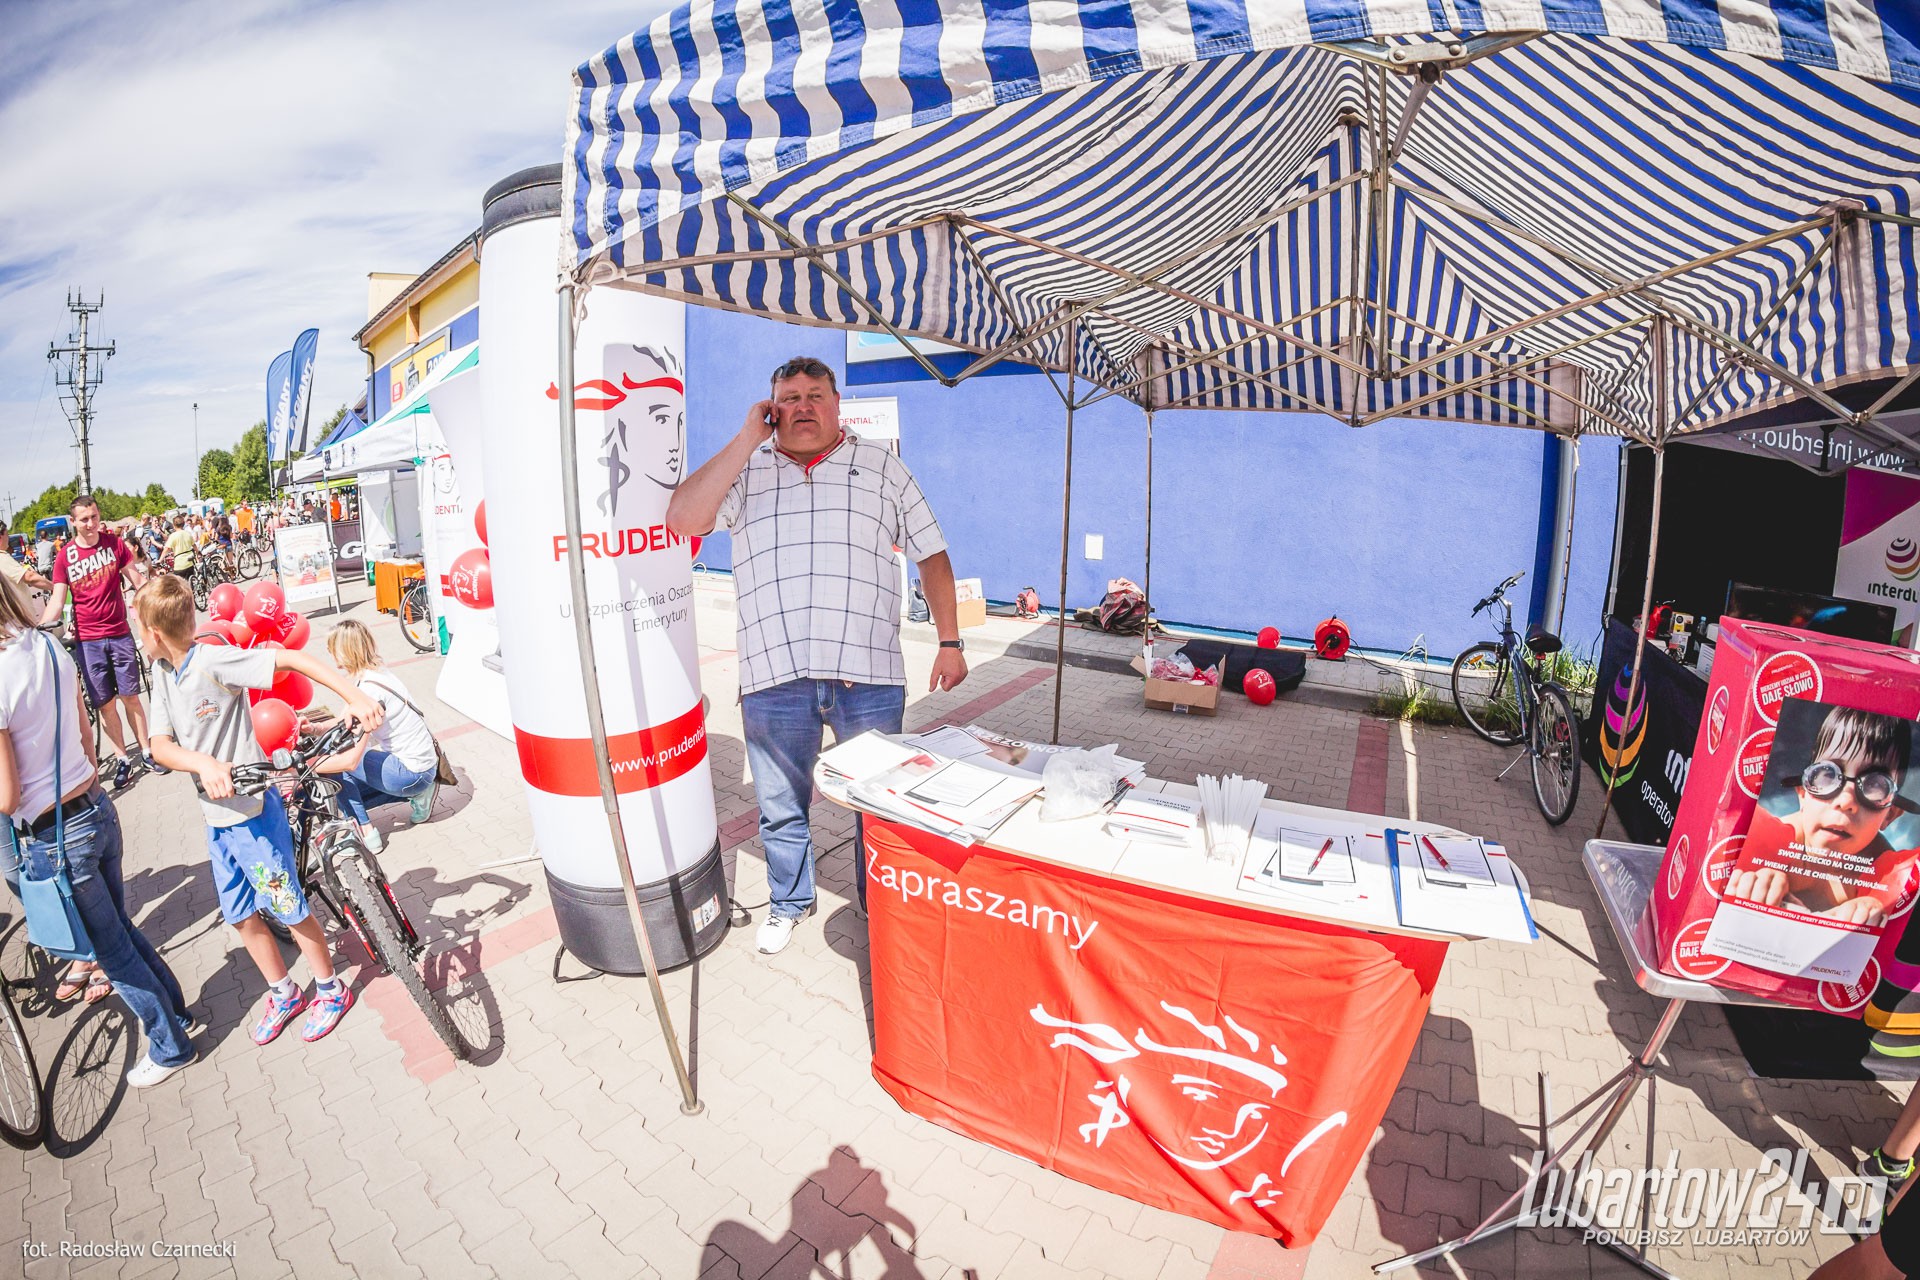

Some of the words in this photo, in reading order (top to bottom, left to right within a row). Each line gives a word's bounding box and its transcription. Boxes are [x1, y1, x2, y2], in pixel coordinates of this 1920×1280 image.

[294, 356, 315, 417] GIANT
[840, 417, 873, 425] DENTIAL
[435, 504, 463, 515] DENTI
[66, 544, 79, 564] 6
[553, 524, 690, 562] PRUDEN
[67, 546, 117, 583] ESPAÑA
[560, 591, 666, 620] Uezpieczenia
[633, 607, 688, 633] Emerytury
[1783, 676, 1814, 698] SŁOWO
[1640, 780, 1675, 829] operator
[1778, 849, 1802, 860] SWOJE
[1802, 854, 1831, 867] DZIECKO
[1832, 860, 1843, 869] NA
[1843, 862, 1854, 871] CO
[1788, 841, 1805, 851] SAM
[1829, 850, 1842, 860] JAK
[1843, 853, 1874, 866] CHRONIĆ
[1752, 857, 1764, 865] MY
[1764, 860, 1789, 872] WIEMY,
[1789, 865, 1803, 875] JAK
[1803, 869, 1812, 877] JE
[1812, 870, 1843, 883] CHRONIĆ
[1842, 877, 1853, 886] NA
[866, 843, 1099, 950] Zapraszamy
[1811, 966, 1841, 976] PRUDENTIAL
